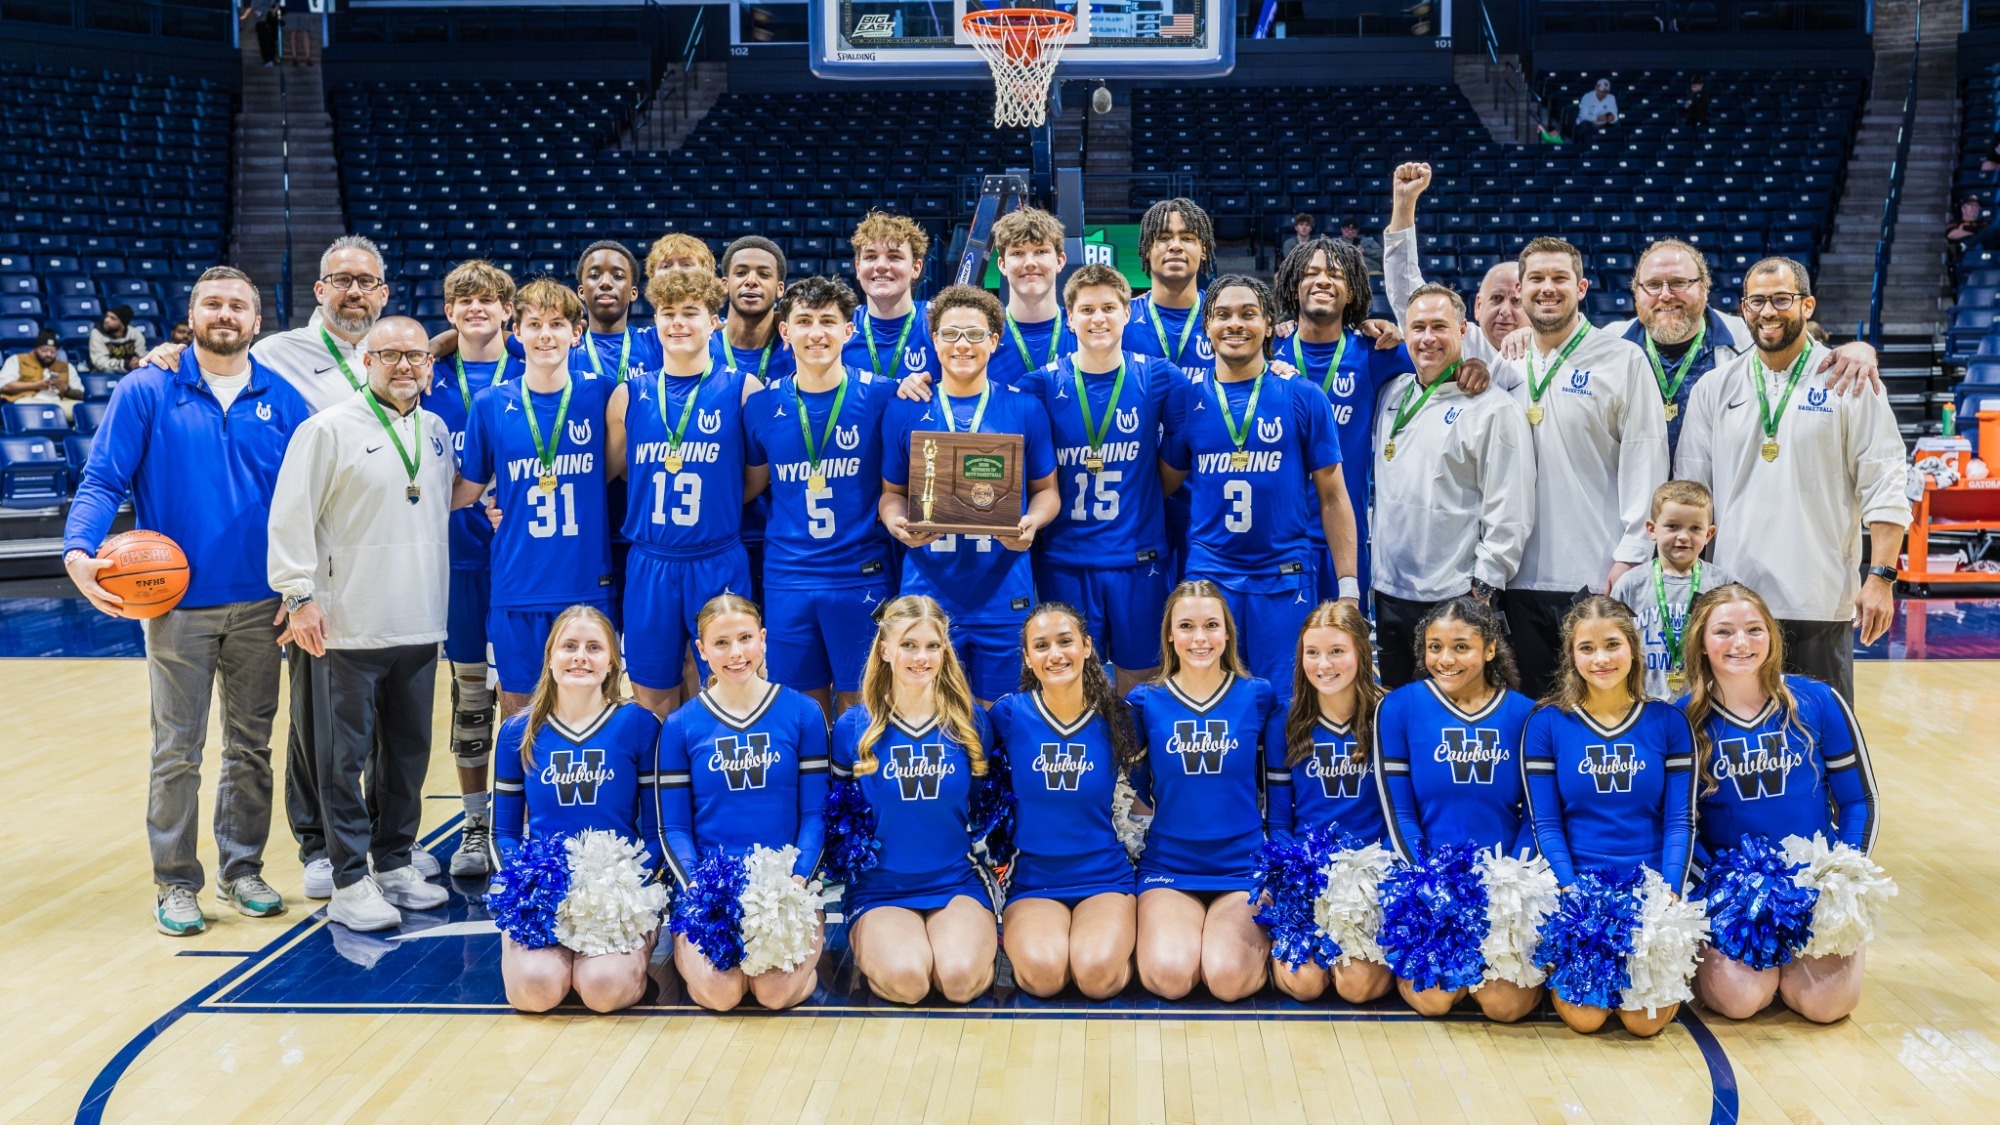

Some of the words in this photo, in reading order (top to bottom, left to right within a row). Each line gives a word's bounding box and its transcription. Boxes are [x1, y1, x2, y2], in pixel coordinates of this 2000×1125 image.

[730, 48, 749, 56] 102
[837, 52, 876, 61] SPALDING
[636, 442, 720, 464] WYOMING
[1056, 441, 1140, 466] WYOMING
[508, 452, 594, 482] WYOMING
[775, 458, 860, 482] WYOMING
[1071, 471, 1122, 521] 15
[1968, 480, 2000, 488] GATORA
[527, 482, 579, 538] 31
[652, 472, 702, 526] 13
[1224, 480, 1252, 533] 3
[806, 487, 835, 539] 5
[120, 548, 172, 567] OHSAA
[143, 578, 165, 586] NFHS
[1165, 734, 1239, 756] Cowboys
[1173, 719, 1229, 775] W
[1434, 743, 1510, 765] Cowboys
[1441, 727, 1500, 784] W
[708, 750, 781, 774] Cowboys
[715, 732, 771, 791] W
[883, 757, 956, 780] Cowboys
[890, 743, 945, 801] W
[1032, 754, 1095, 775] Cowboys
[1041, 742, 1086, 791] W
[1305, 758, 1375, 779] Cowboys
[1313, 742, 1363, 798] W
[1578, 756, 1646, 776] Cowboys
[1586, 744, 1635, 793] W
[1713, 751, 1802, 780] Cowboys
[1718, 731, 1788, 801] W
[540, 764, 615, 787] Cowboys
[550, 749, 605, 806] W
[1144, 875, 1174, 884] Cowboys
